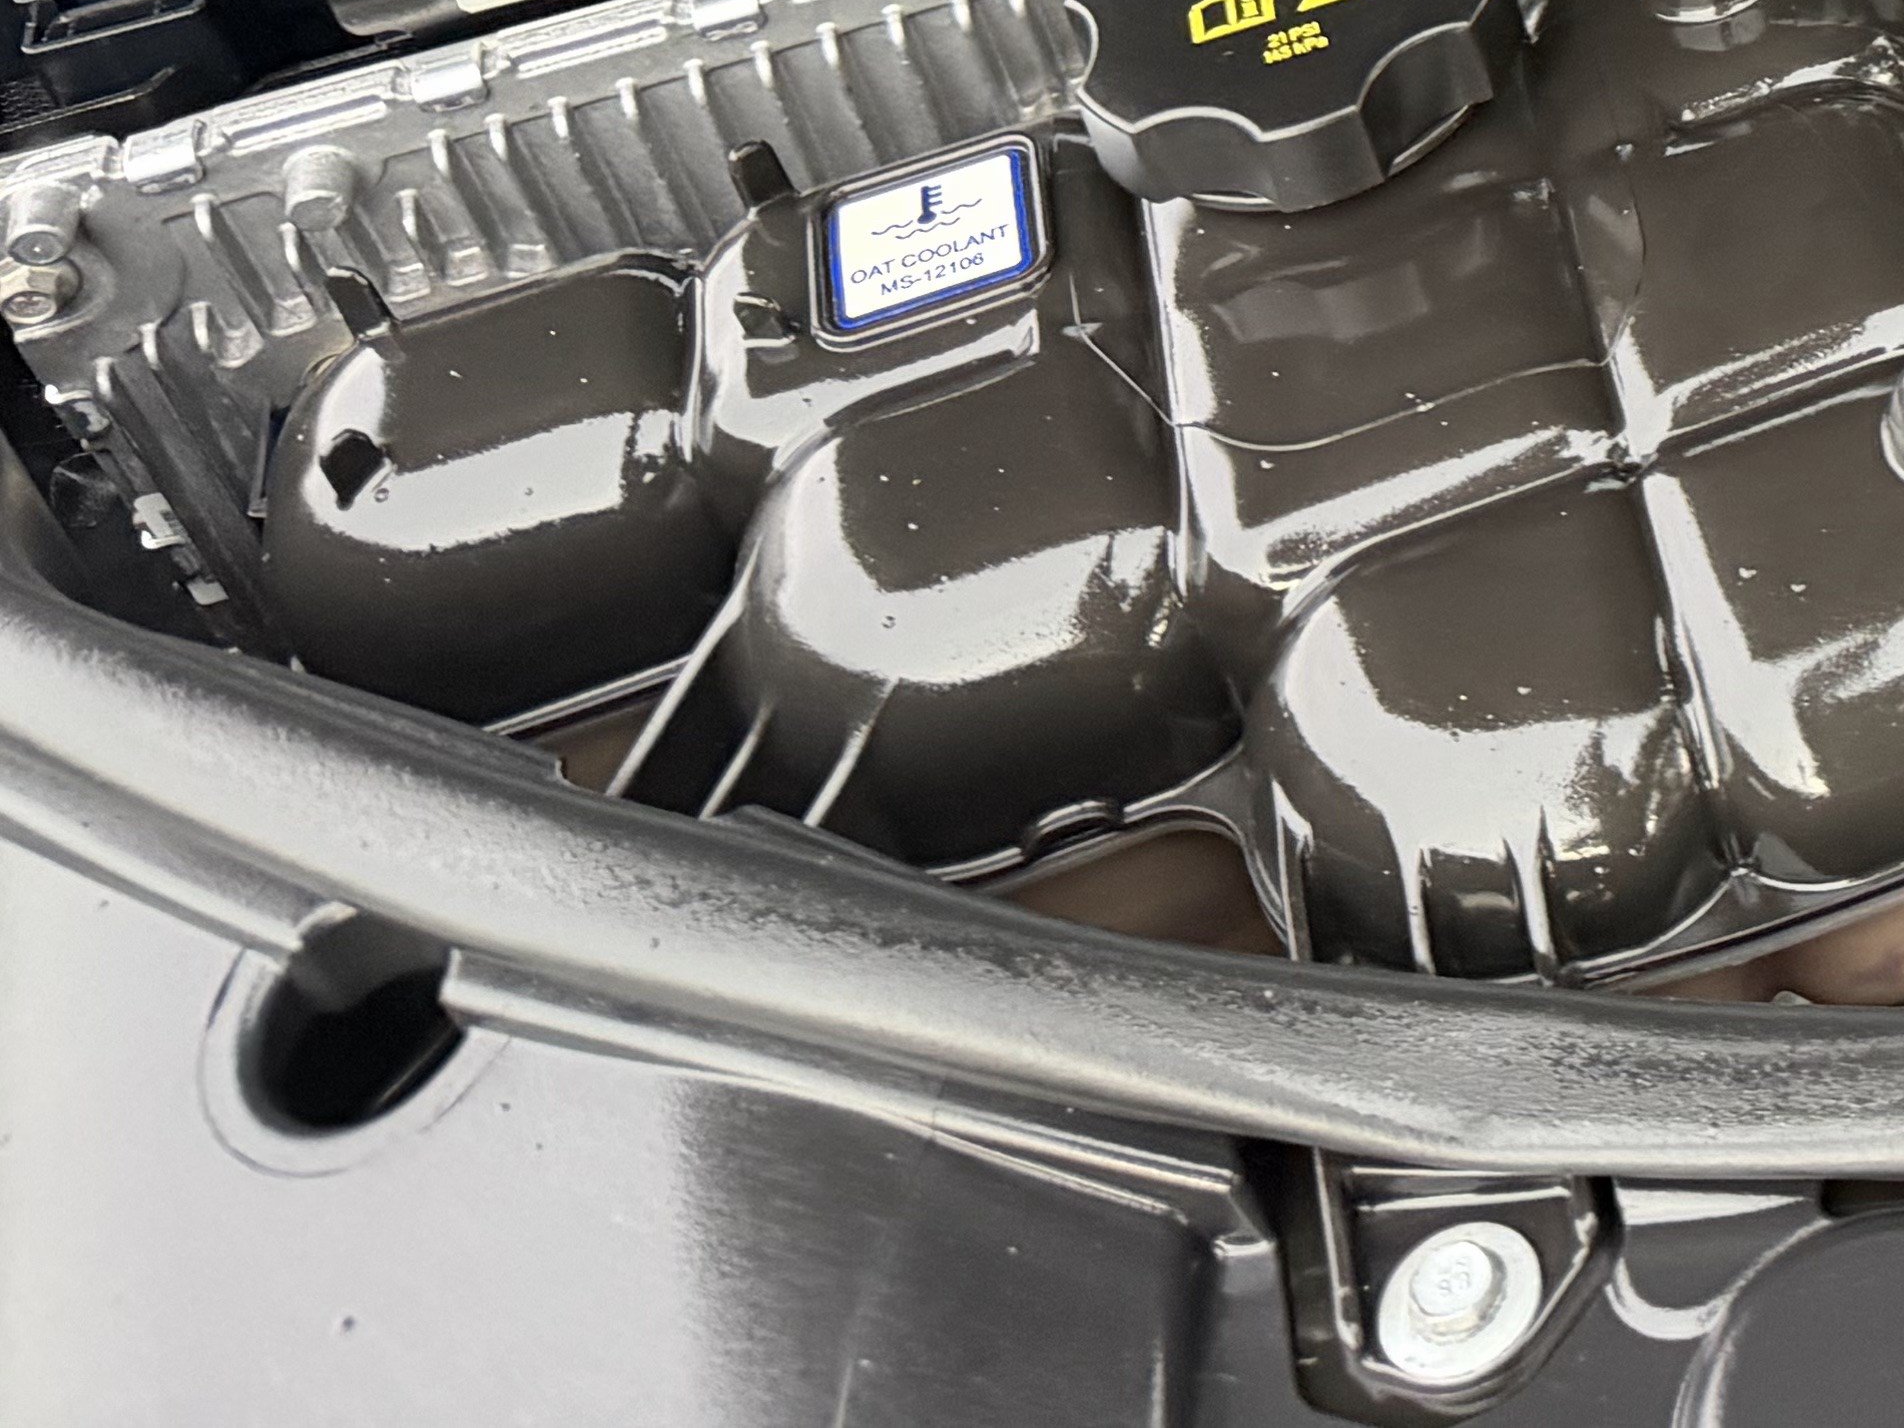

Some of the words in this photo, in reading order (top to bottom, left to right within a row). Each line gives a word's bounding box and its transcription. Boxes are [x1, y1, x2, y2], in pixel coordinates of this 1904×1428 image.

[850, 258, 896, 285] OAT
[901, 224, 1009, 269] COOLANT
[880, 252, 985, 296] MS-12106
